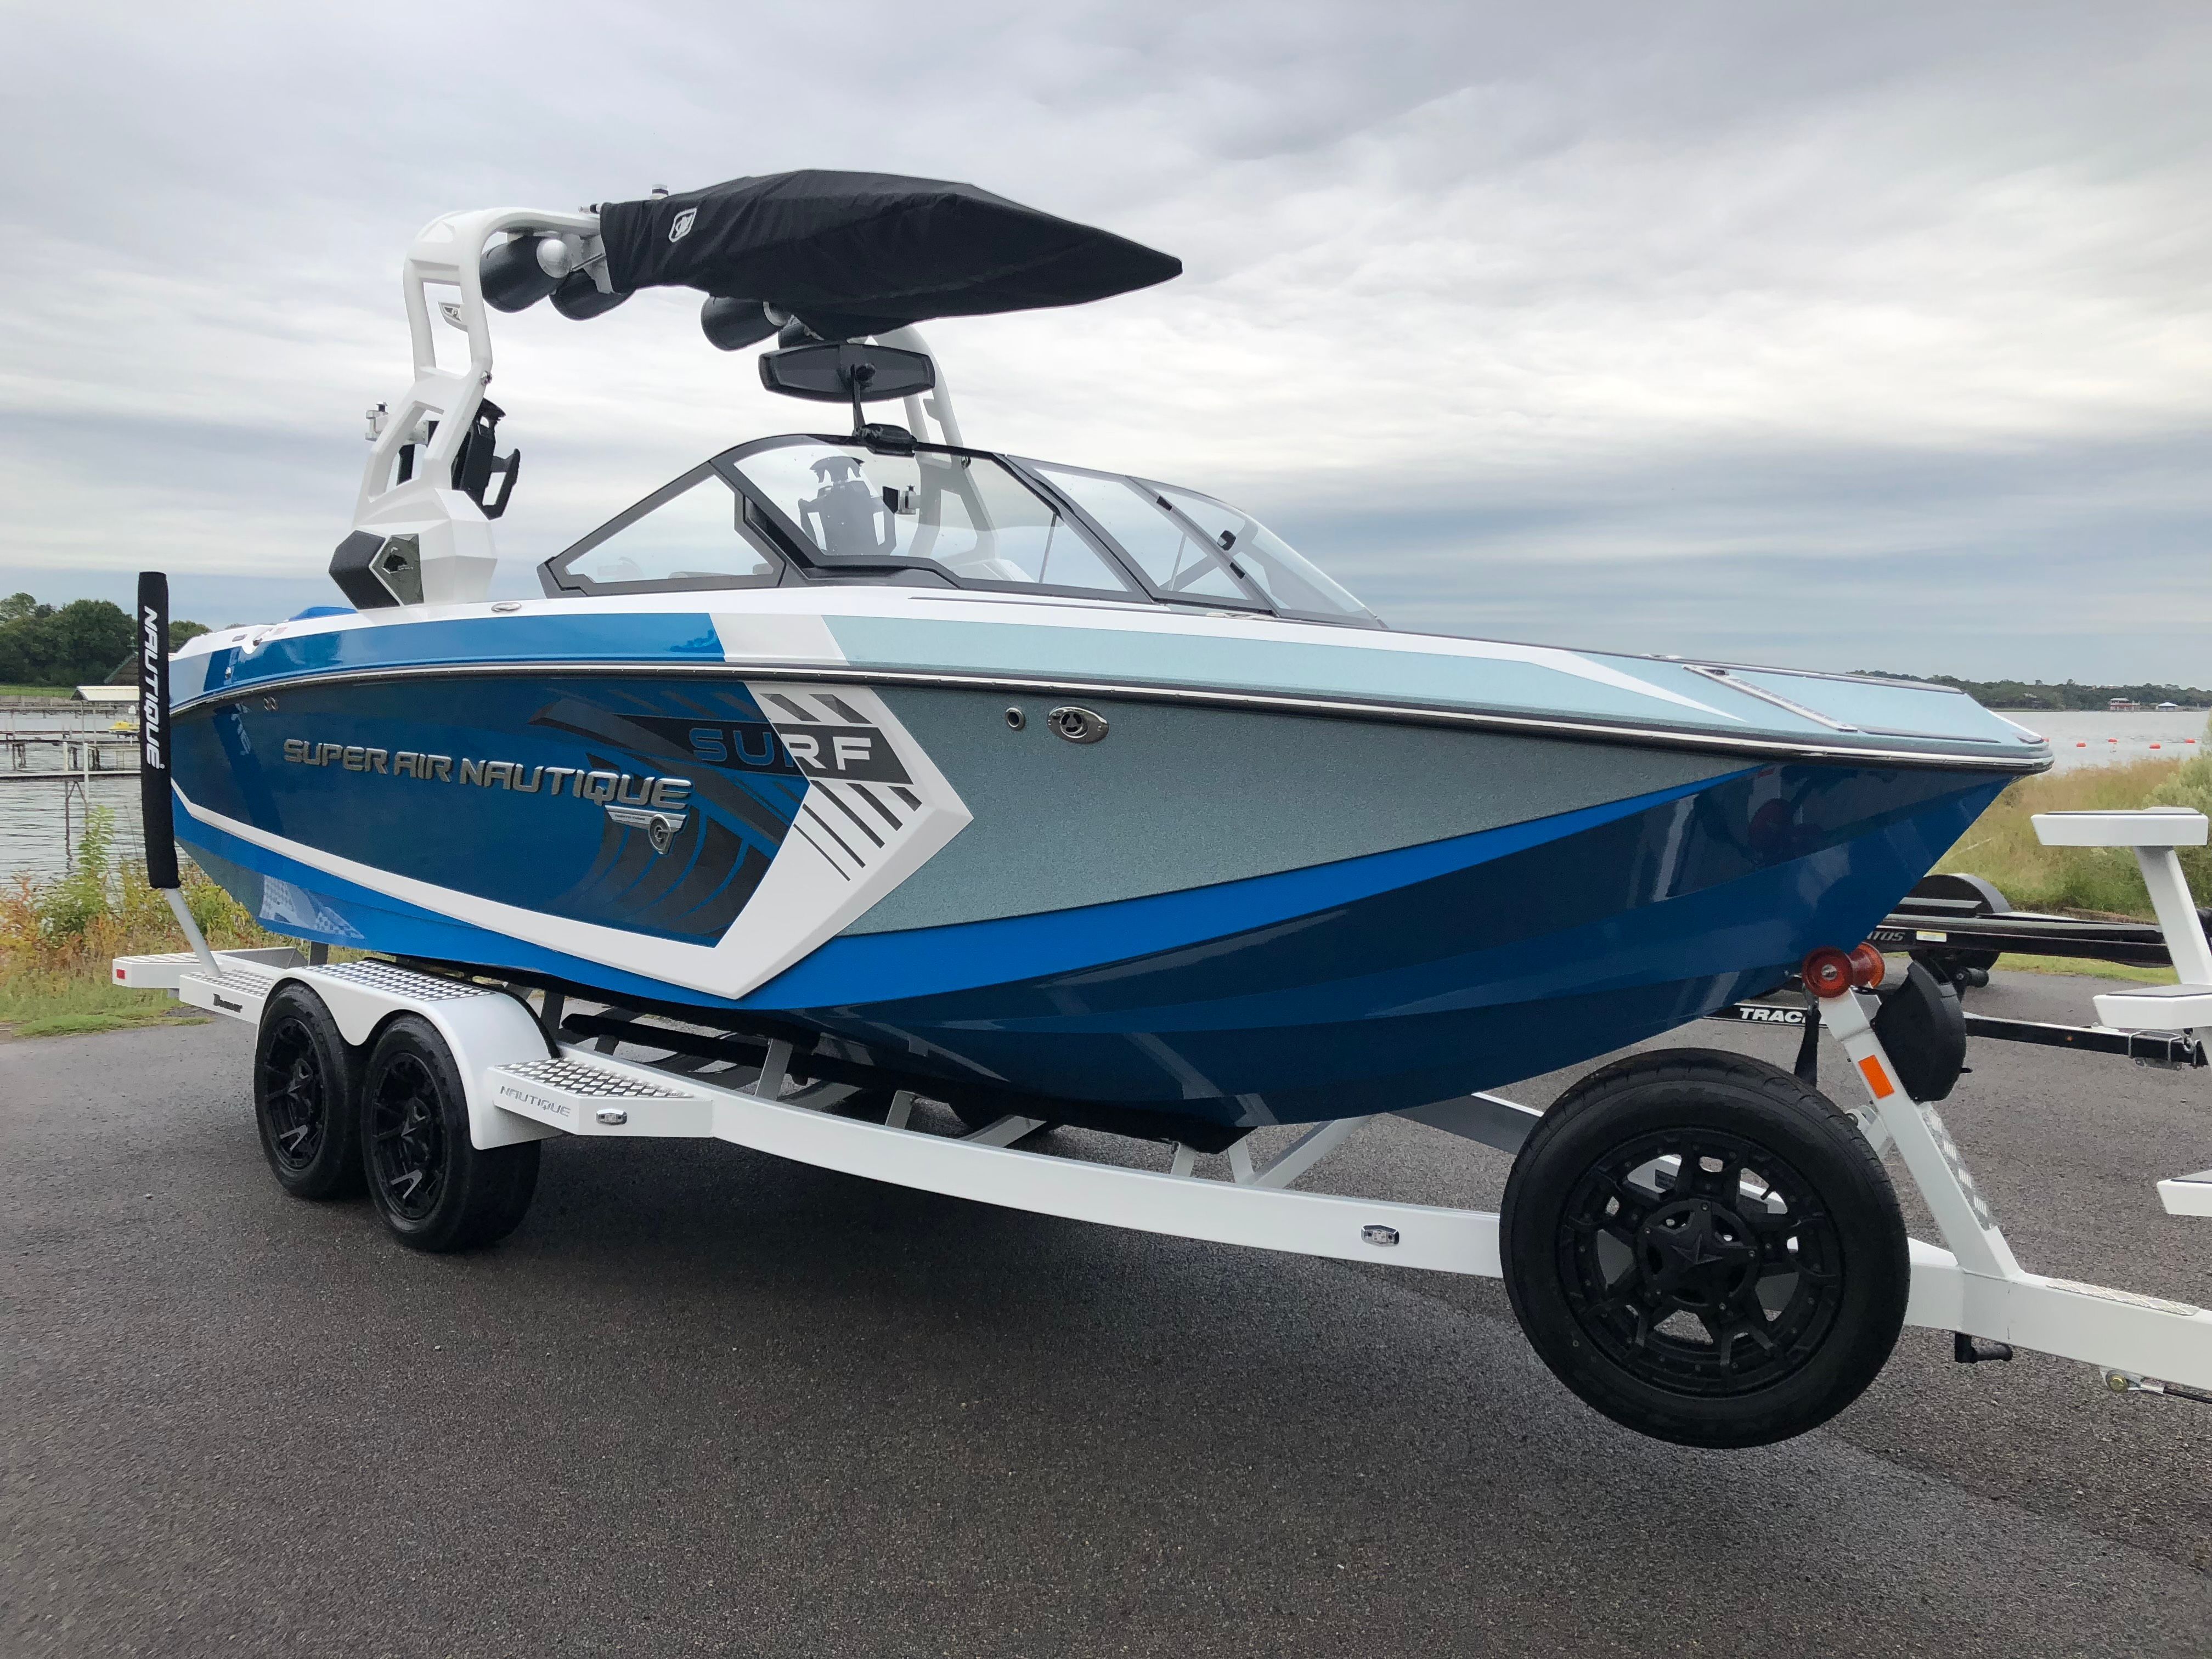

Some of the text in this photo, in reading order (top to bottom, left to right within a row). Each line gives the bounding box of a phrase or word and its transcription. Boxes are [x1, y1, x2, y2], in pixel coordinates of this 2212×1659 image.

[144, 606, 160, 769] NAUTIQUE
[689, 727, 872, 771] SURF
[283, 738, 692, 810] SUPER AIR NAUTIQUE
[1740, 1007, 1806, 1023] TRAC
[500, 1085, 572, 1118] NAUTIQUE
